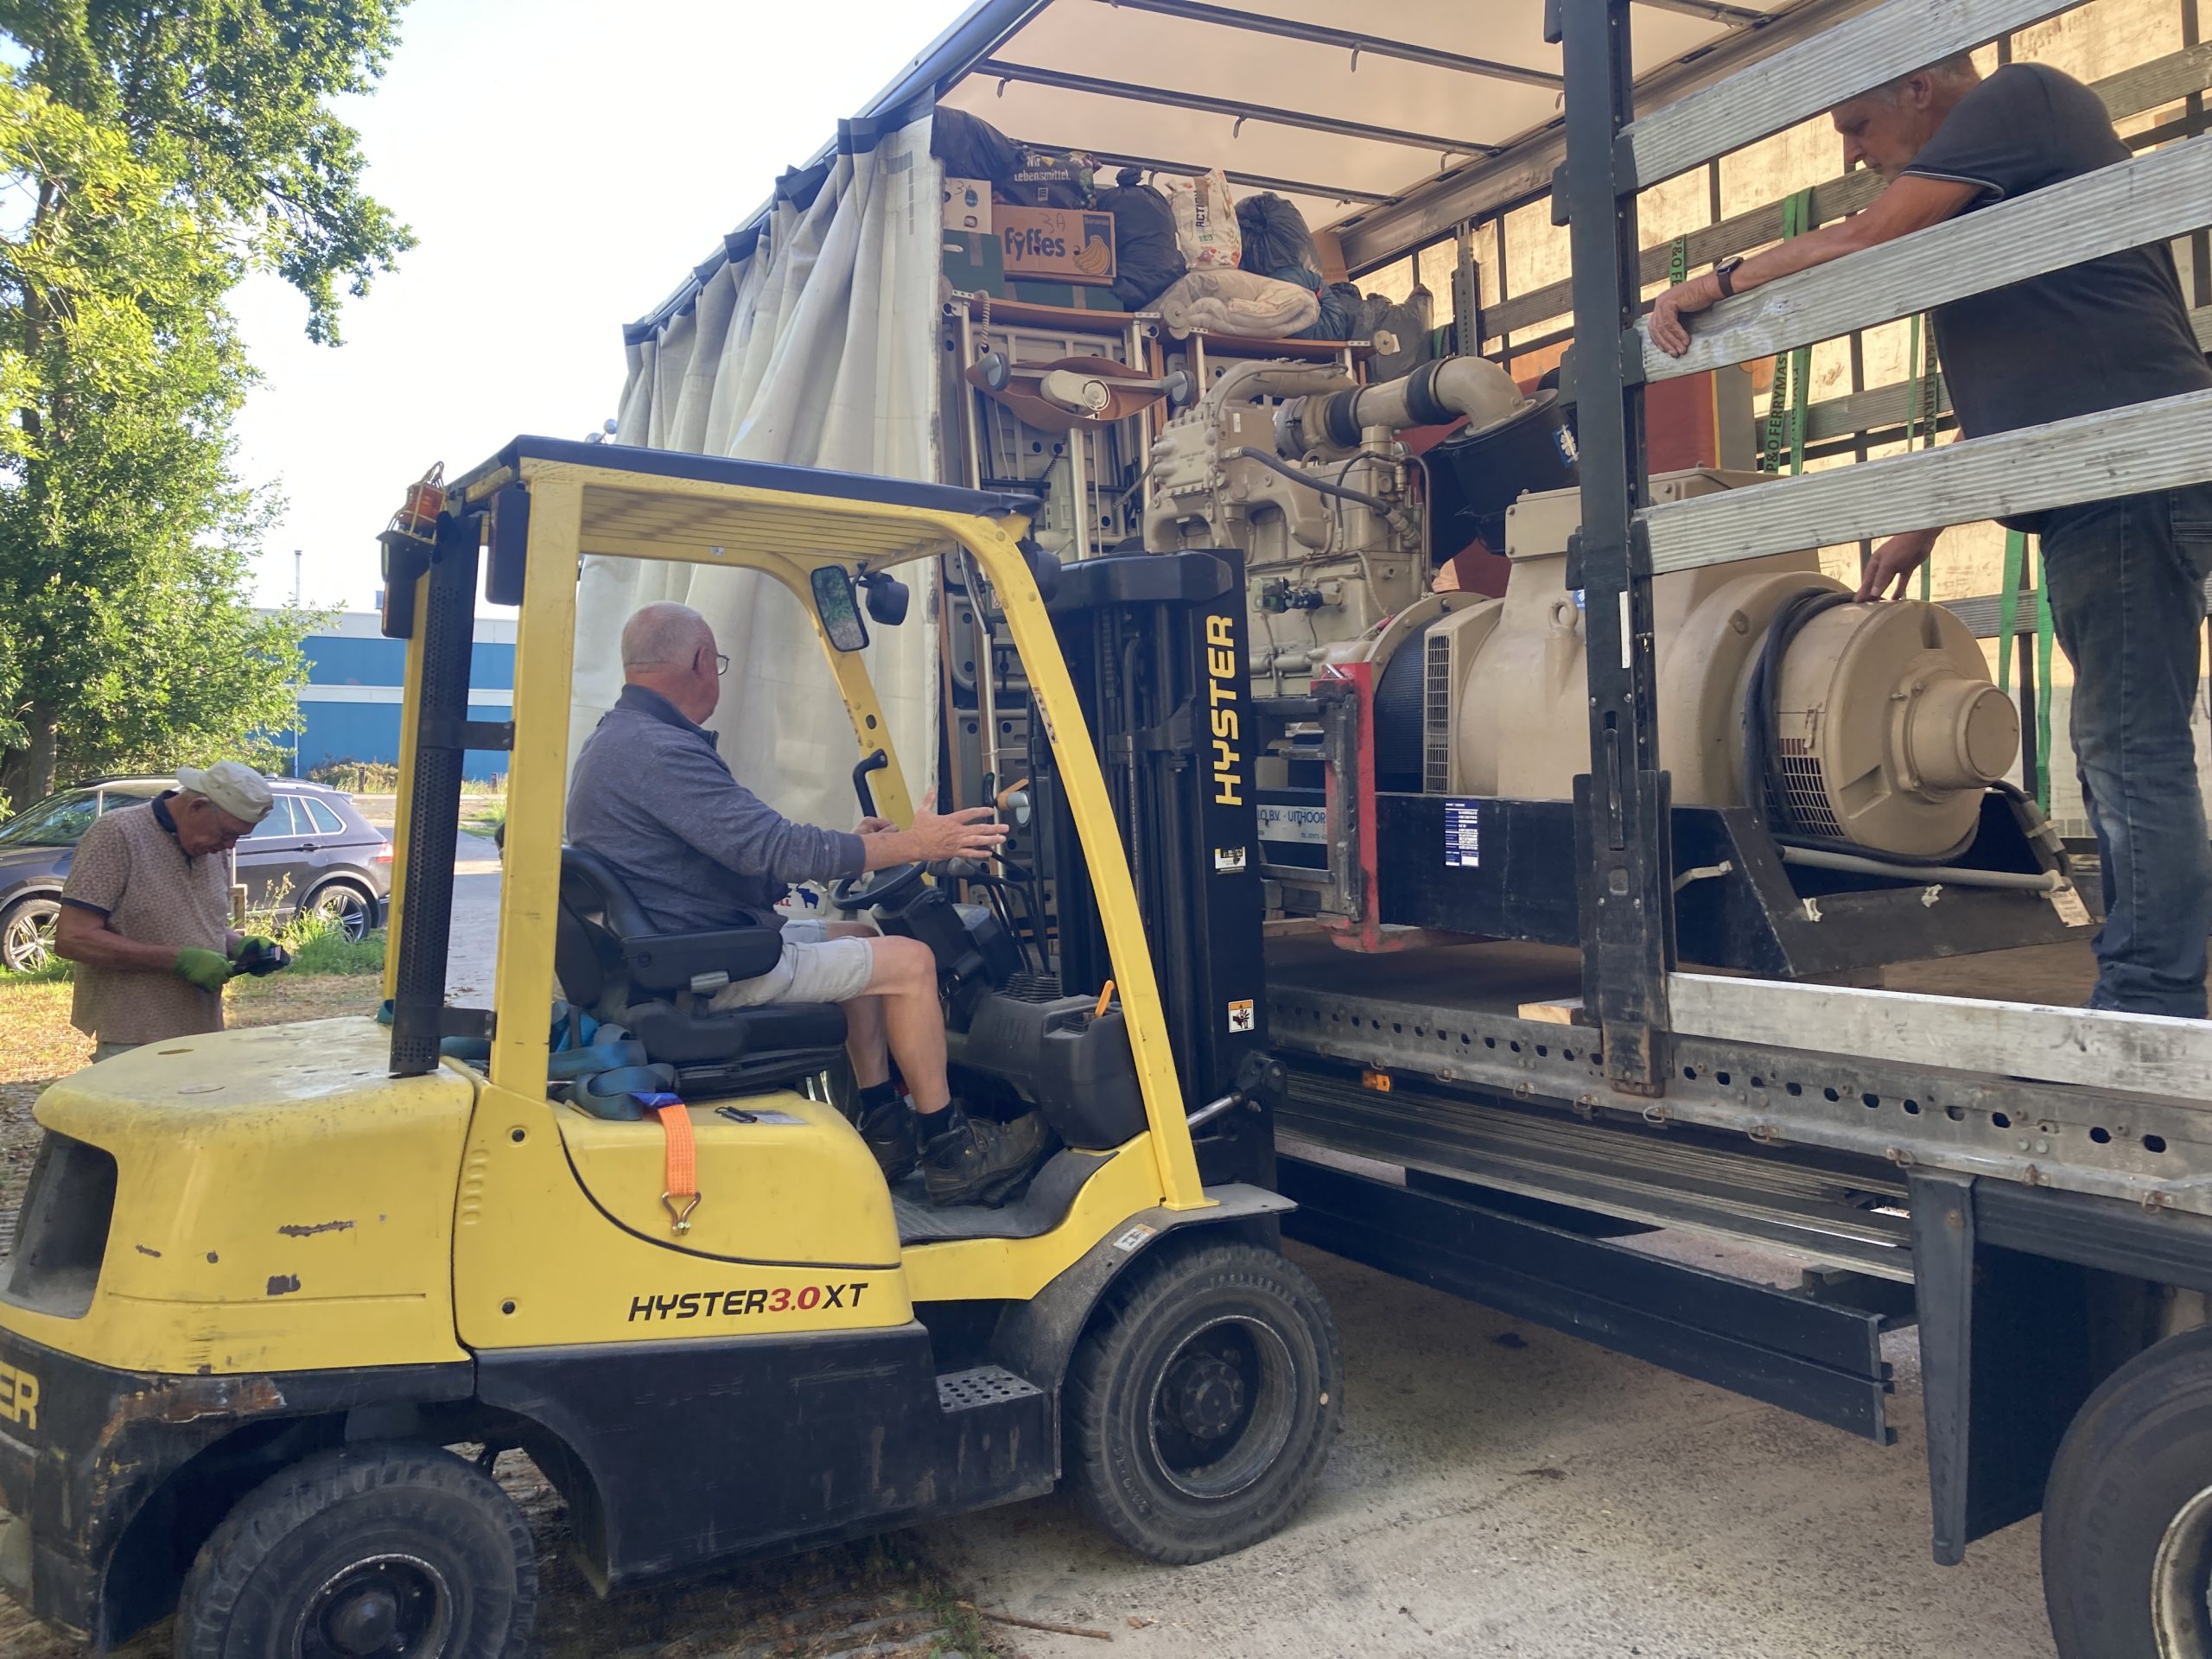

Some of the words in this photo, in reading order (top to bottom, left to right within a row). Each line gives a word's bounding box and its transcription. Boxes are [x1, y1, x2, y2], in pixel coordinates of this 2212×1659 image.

[1039, 212, 1066, 234] 3A
[1671, 236, 1683, 268] P&O
[1768, 352, 1789, 436] FERRYMAS
[1765, 439, 1780, 472] P&O
[1205, 614, 1243, 806] HYSTER
[1287, 810, 1326, 823] UITHOOR
